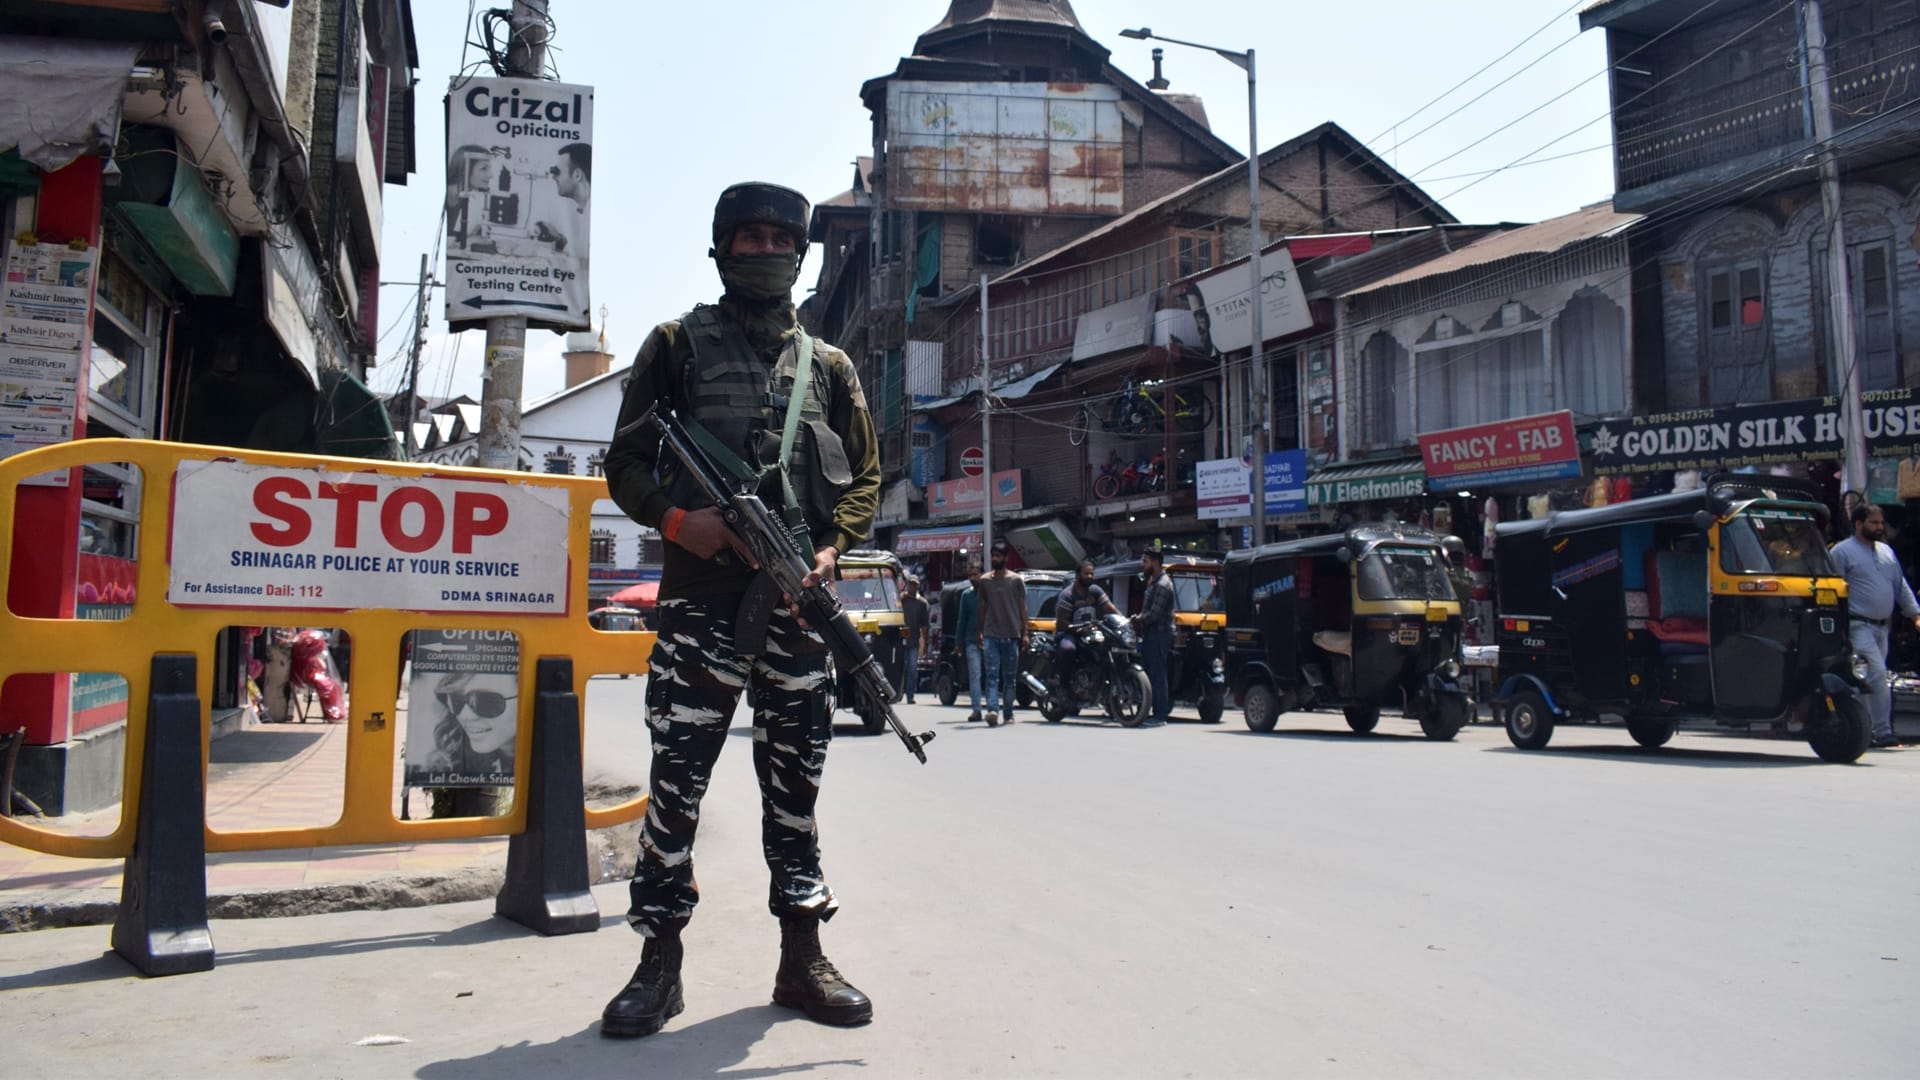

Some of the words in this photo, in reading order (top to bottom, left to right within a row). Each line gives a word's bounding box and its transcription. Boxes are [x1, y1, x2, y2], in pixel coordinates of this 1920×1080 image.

[465, 86, 582, 124] Crizal
[496, 120, 581, 141] Opticians
[455, 262, 549, 279] Computerized
[553, 268, 576, 282] Eye
[467, 278, 515, 292] Testing
[519, 280, 563, 295] Centre
[9, 289, 52, 302] Kashmir
[8, 356, 66, 369] OBSERVER
[1622, 421, 1731, 457] GOLDEN
[1738, 414, 1807, 448] SILK
[1429, 435, 1497, 464] FANCY
[1518, 425, 1563, 452] FAB
[1308, 484, 1320, 505] M
[1324, 482, 1334, 503] Y
[1337, 477, 1424, 502] Electronics
[249, 476, 509, 554] STOP
[230, 550, 316, 570] SRINAGAR
[322, 555, 381, 573] POLICE
[386, 558, 404, 573] AT
[410, 558, 450, 575] YOUR
[455, 560, 520, 577] SERVICE
[184, 581, 202, 594] For
[205, 582, 263, 595] Assistance
[266, 584, 295, 597] Dail:
[299, 585, 323, 598] 112
[441, 590, 482, 602] DDMA
[485, 591, 555, 604] SRINAGAR
[442, 629, 519, 642] OPTICIA
[427, 652, 480, 661] COMPUTERIZED
[456, 663, 491, 671] COMPLETE
[492, 664, 505, 672] EYE
[448, 772, 486, 784] Chowk
